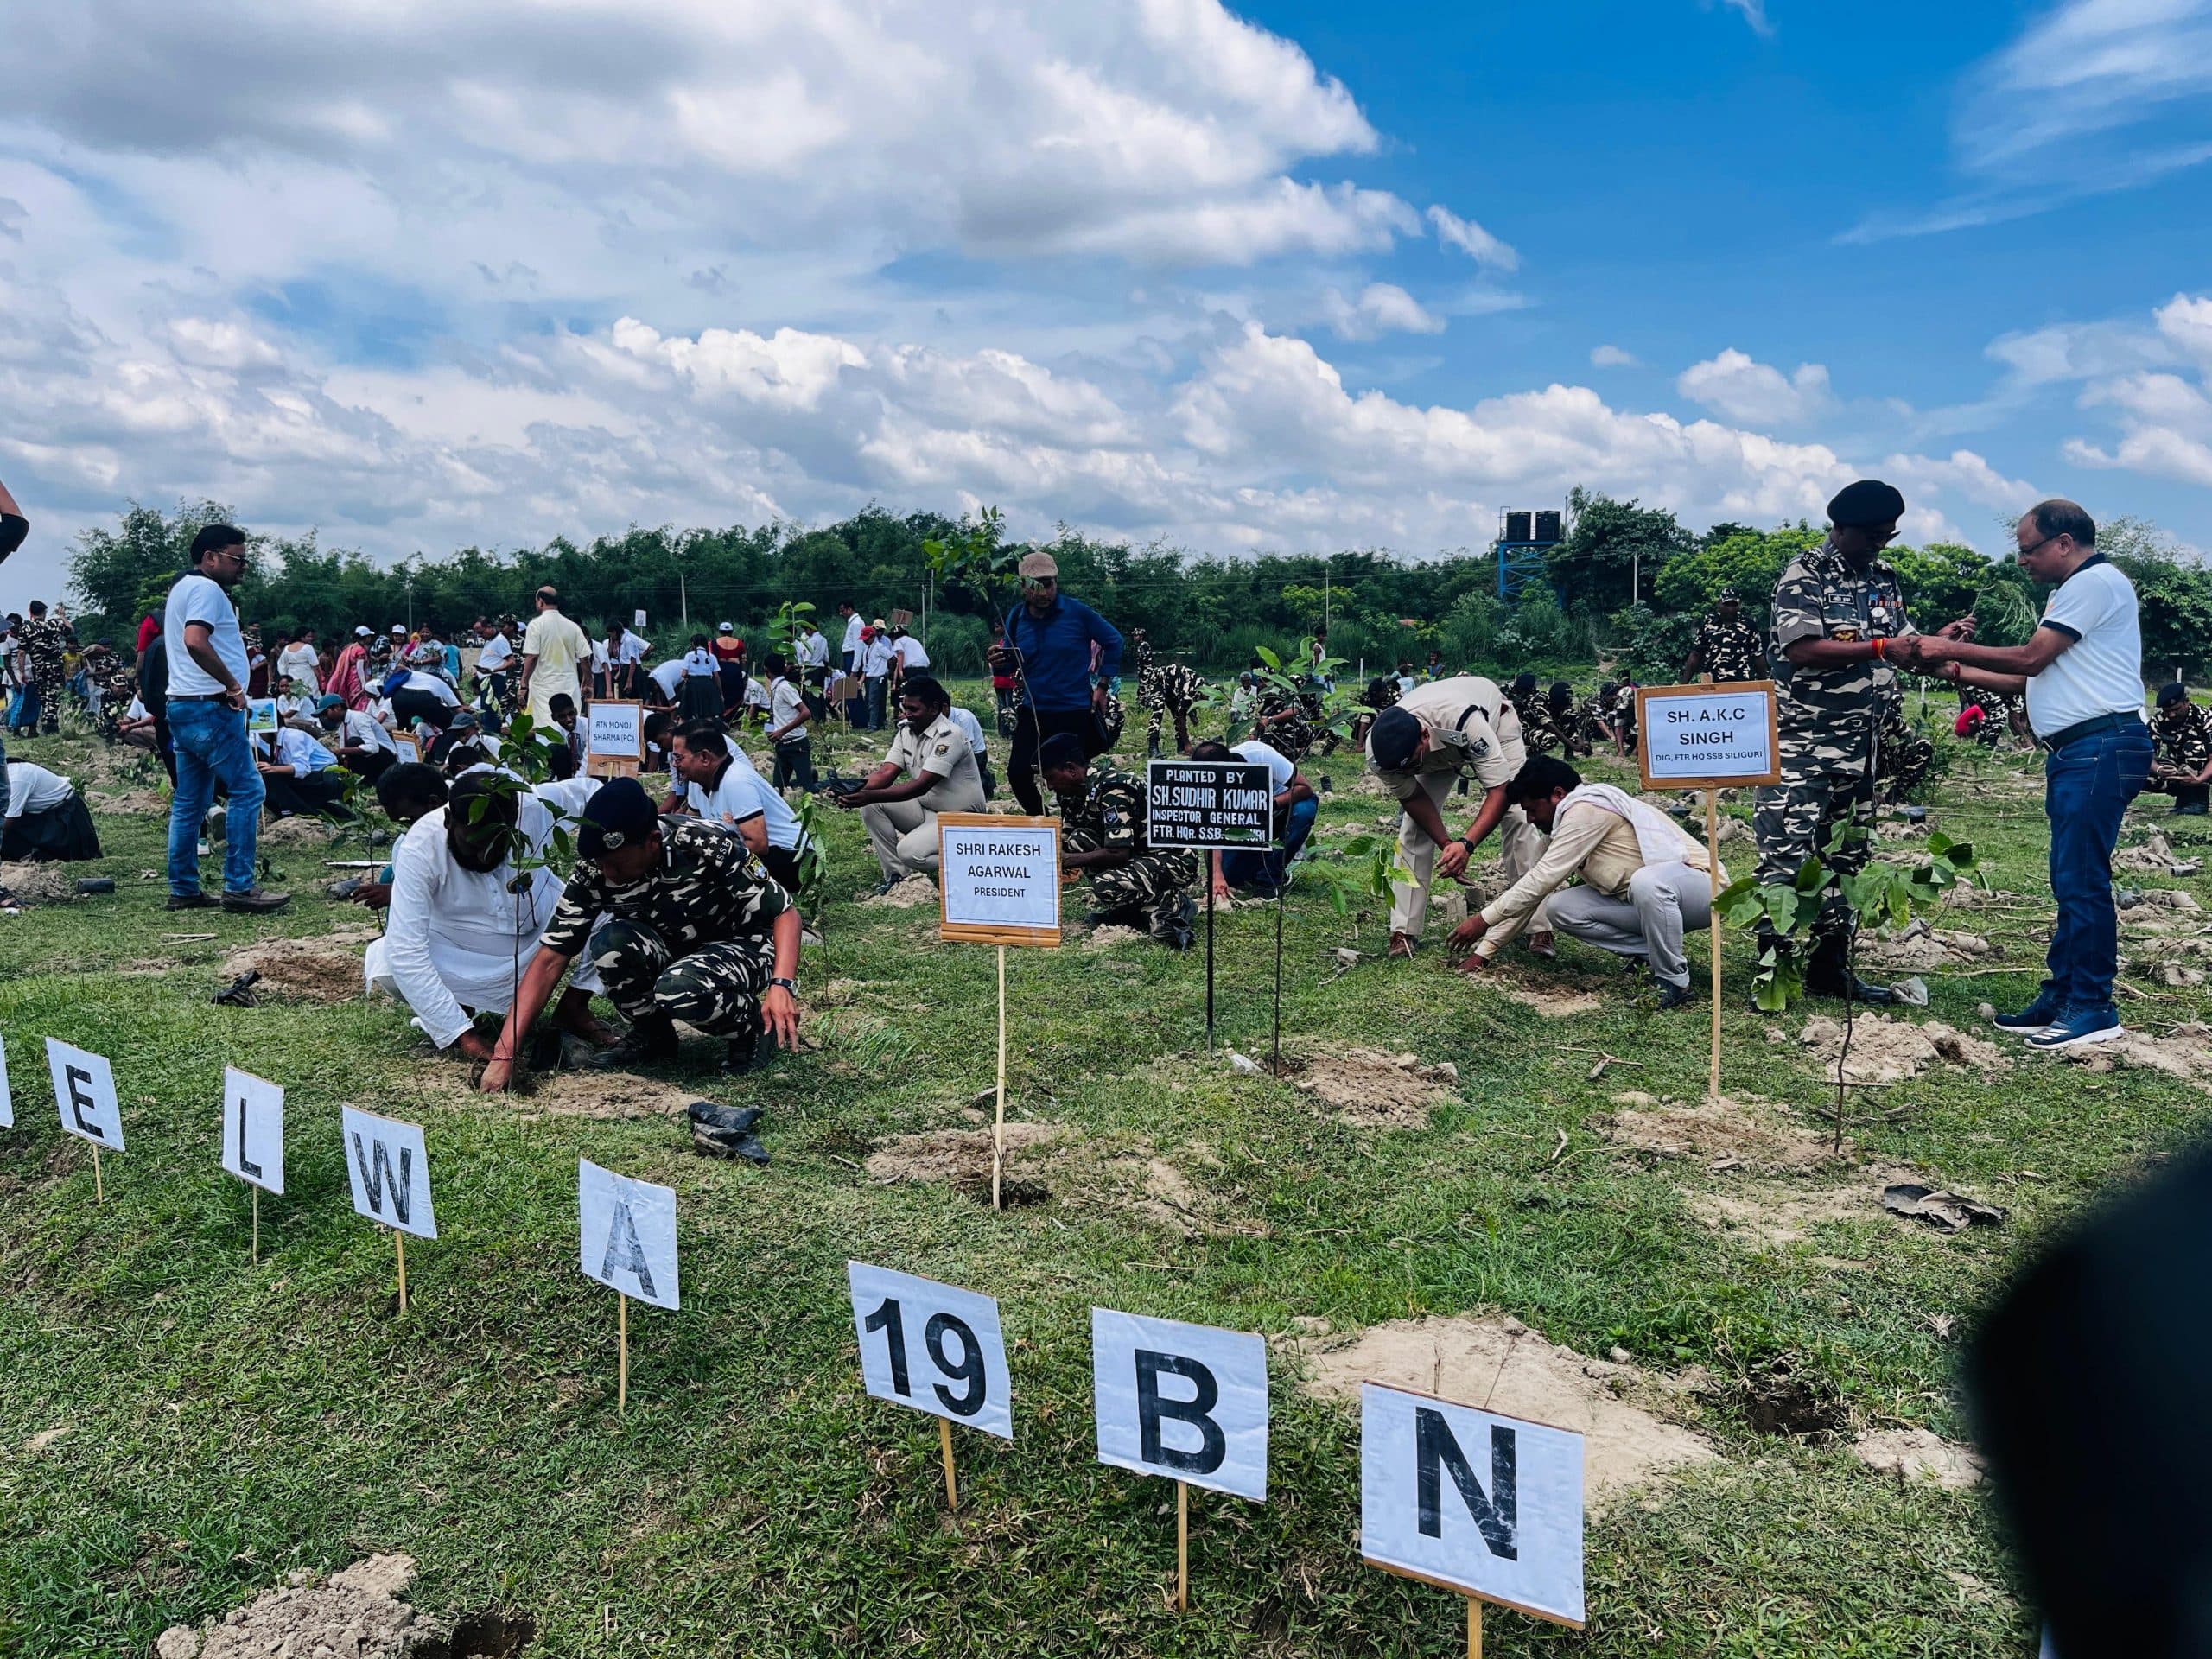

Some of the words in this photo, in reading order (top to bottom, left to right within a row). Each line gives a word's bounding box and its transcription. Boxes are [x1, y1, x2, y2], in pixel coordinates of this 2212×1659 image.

[1667, 710, 1695, 723] SH.
[1700, 708, 1745, 722] A.K.C
[594, 733, 620, 741] SHARMA
[621, 734, 635, 743] (PC)
[1680, 731, 1733, 745] SINGH
[1166, 769, 1216, 783] PLANTED
[1226, 772, 1246, 785] BY
[1223, 789, 1268, 810] KUMAR
[1152, 809, 1202, 823] INSPECTOR
[1210, 811, 1261, 825] GENERAL
[1153, 824, 1174, 838] FTR.
[716, 841, 729, 861] SSB
[956, 842, 985, 855] SHRI
[988, 843, 1041, 856] RAKESH
[968, 865, 1031, 879] AGARWAL
[974, 887, 1026, 898] PRESIDENT
[66, 1064, 104, 1138] E
[240, 1097, 262, 1179] L
[352, 1131, 412, 1225] W
[601, 1201, 658, 1299] A
[865, 1297, 987, 1417] 19
[1134, 1348, 1226, 1475] B
[1415, 1406, 1518, 1561] N
